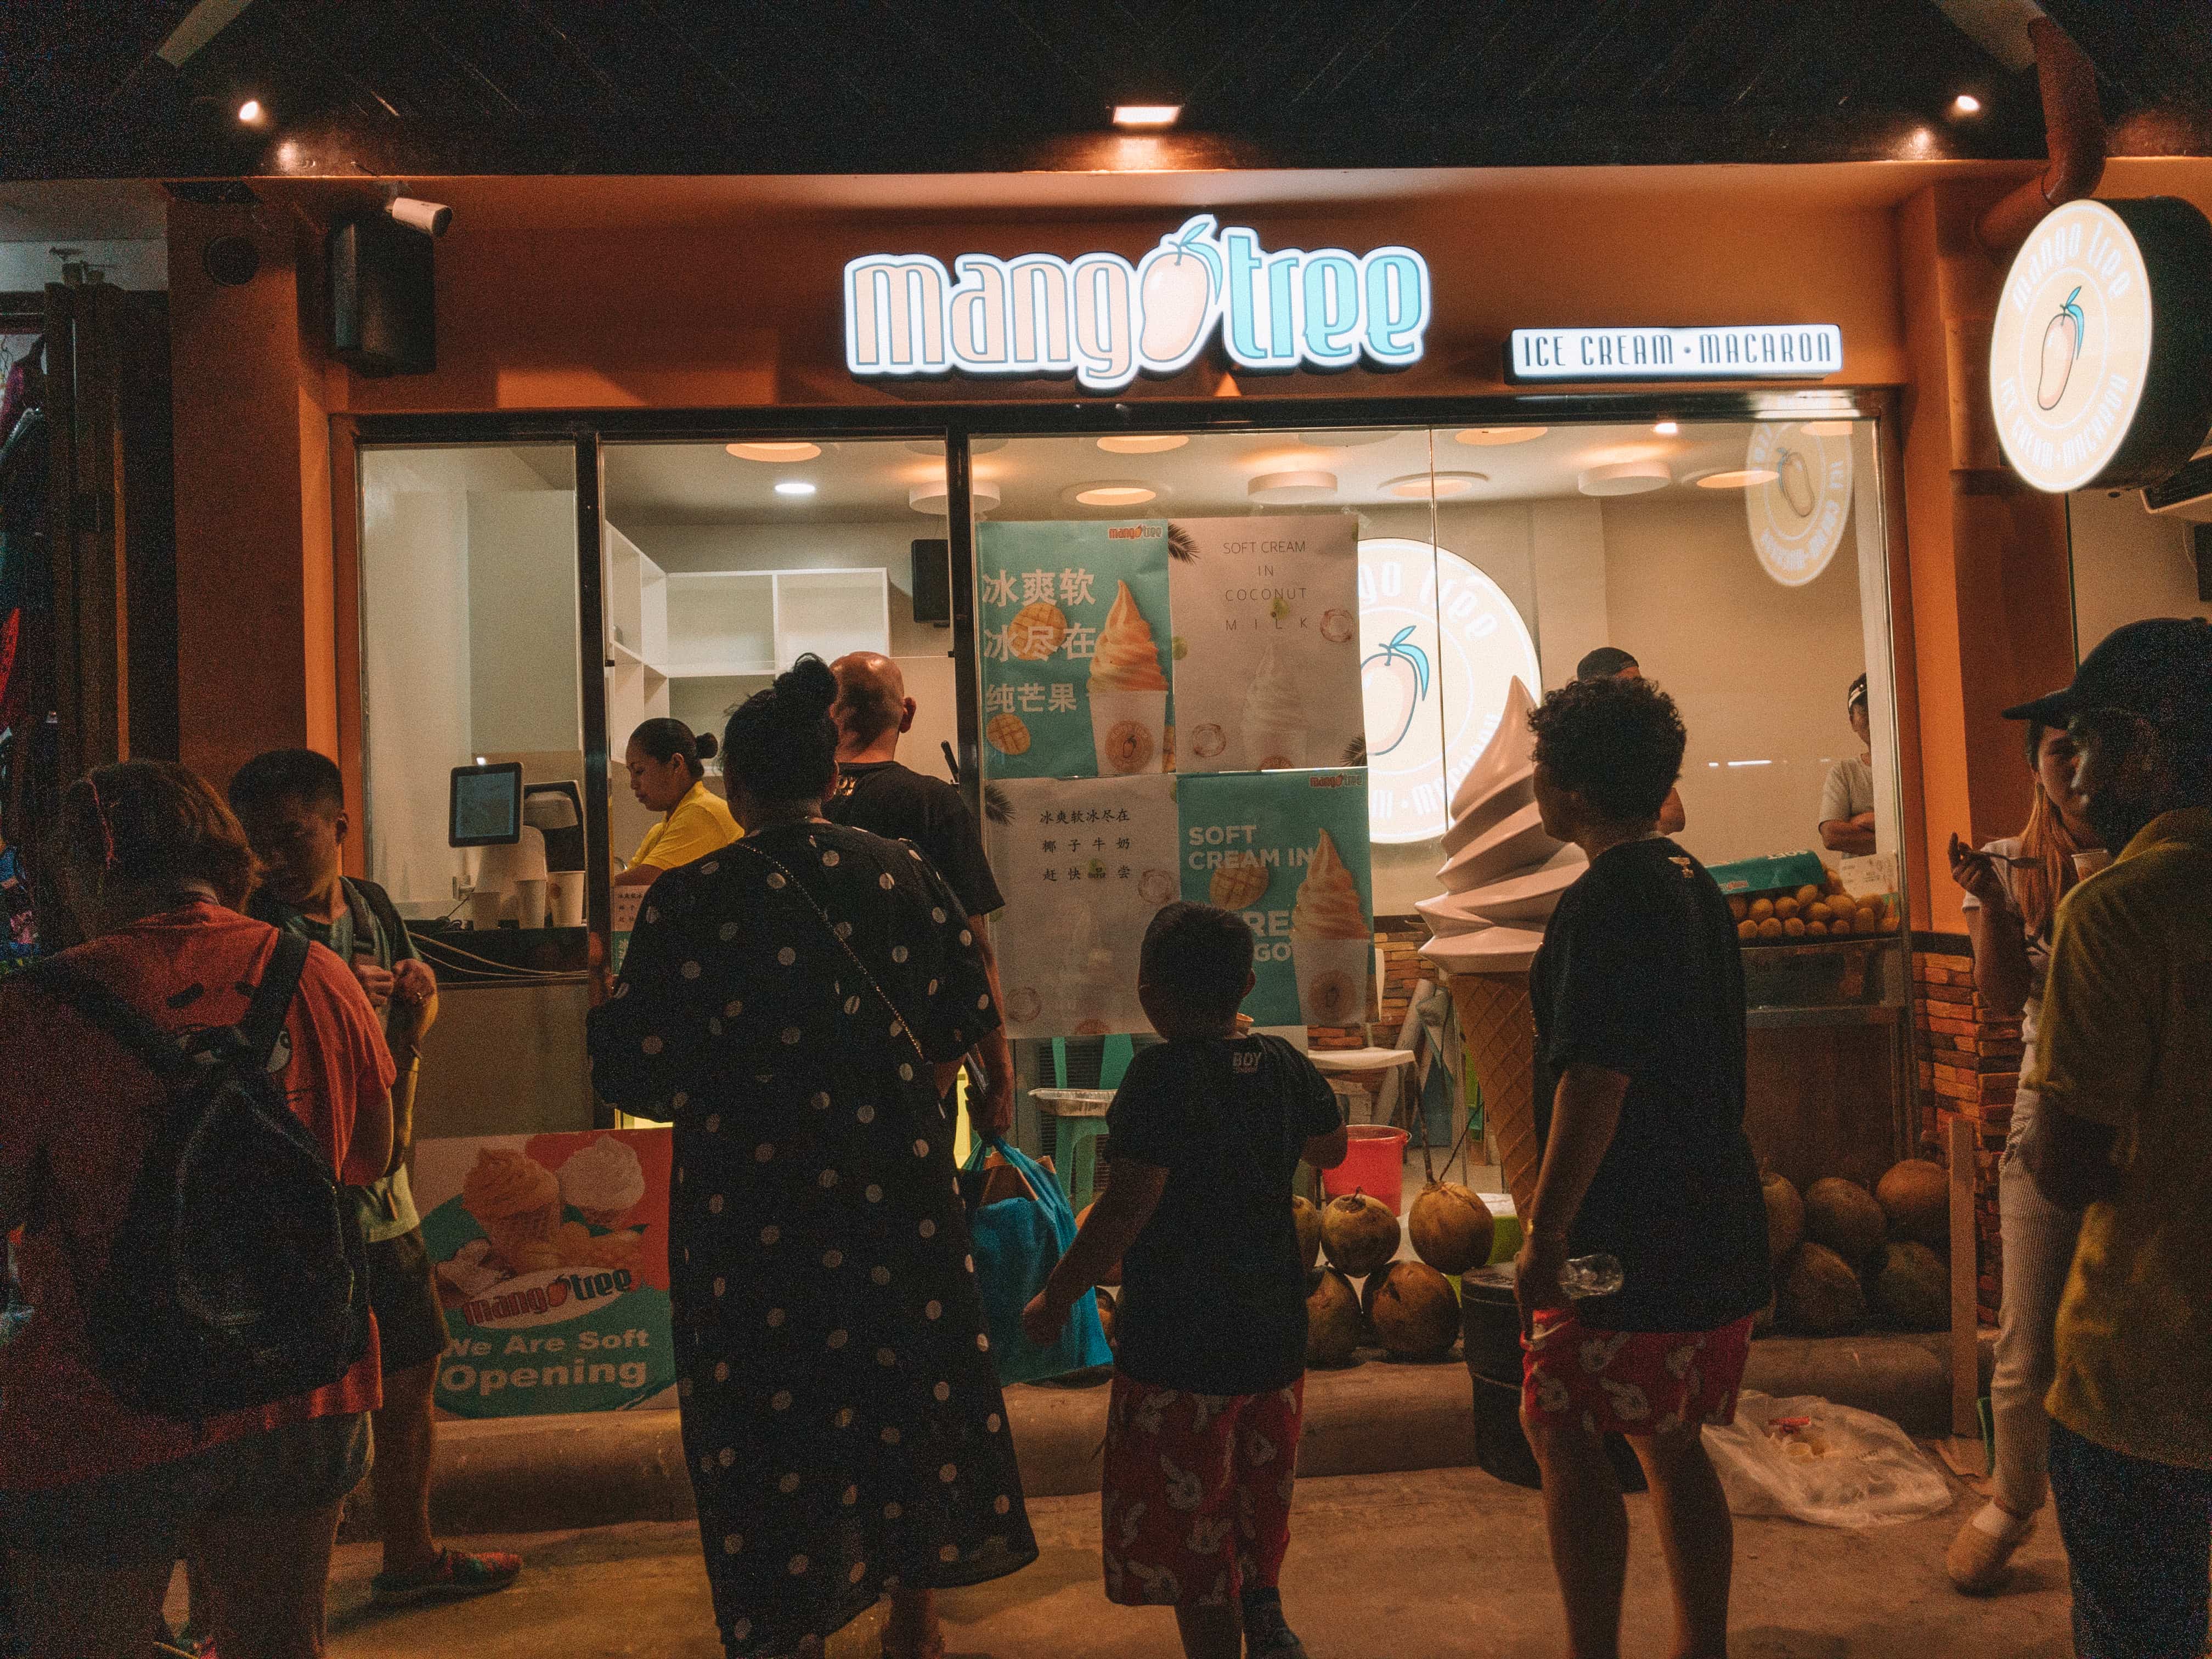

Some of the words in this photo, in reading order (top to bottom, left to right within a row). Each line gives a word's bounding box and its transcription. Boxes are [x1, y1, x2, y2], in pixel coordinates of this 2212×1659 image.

[850, 230, 1215, 381] mango
[1226, 233, 1424, 362] tree
[1523, 335, 1566, 366] ICE
[1580, 334, 1673, 366] CREAM
[1700, 332, 1831, 364] MACARON
[1108, 524, 1142, 540] mango
[1143, 525, 1163, 538] tree
[1223, 541, 1256, 555] SOFT
[1260, 540, 1306, 554] CREAM
[1257, 565, 1274, 577] IN
[982, 568, 1097, 607] 冰爽软
[1225, 588, 1307, 602] COCONUT
[983, 622, 1097, 662] 冰尽在
[987, 682, 1078, 714] 纯芒果
[1040, 808, 1131, 825] 冰爽软冰尽在
[1042, 837, 1131, 853] 椰子牛奶
[1188, 824, 1257, 847] SOFT
[1188, 847, 1280, 870] CREAM
[1288, 846, 1317, 867] IN
[1232, 1052, 1262, 1067] BOY
[462, 1276, 569, 1327] mango
[569, 1268, 633, 1301] tree
[503, 1334, 566, 1355] Are
[578, 1328, 651, 1351] Soft
[441, 1358, 648, 1396] Opening
